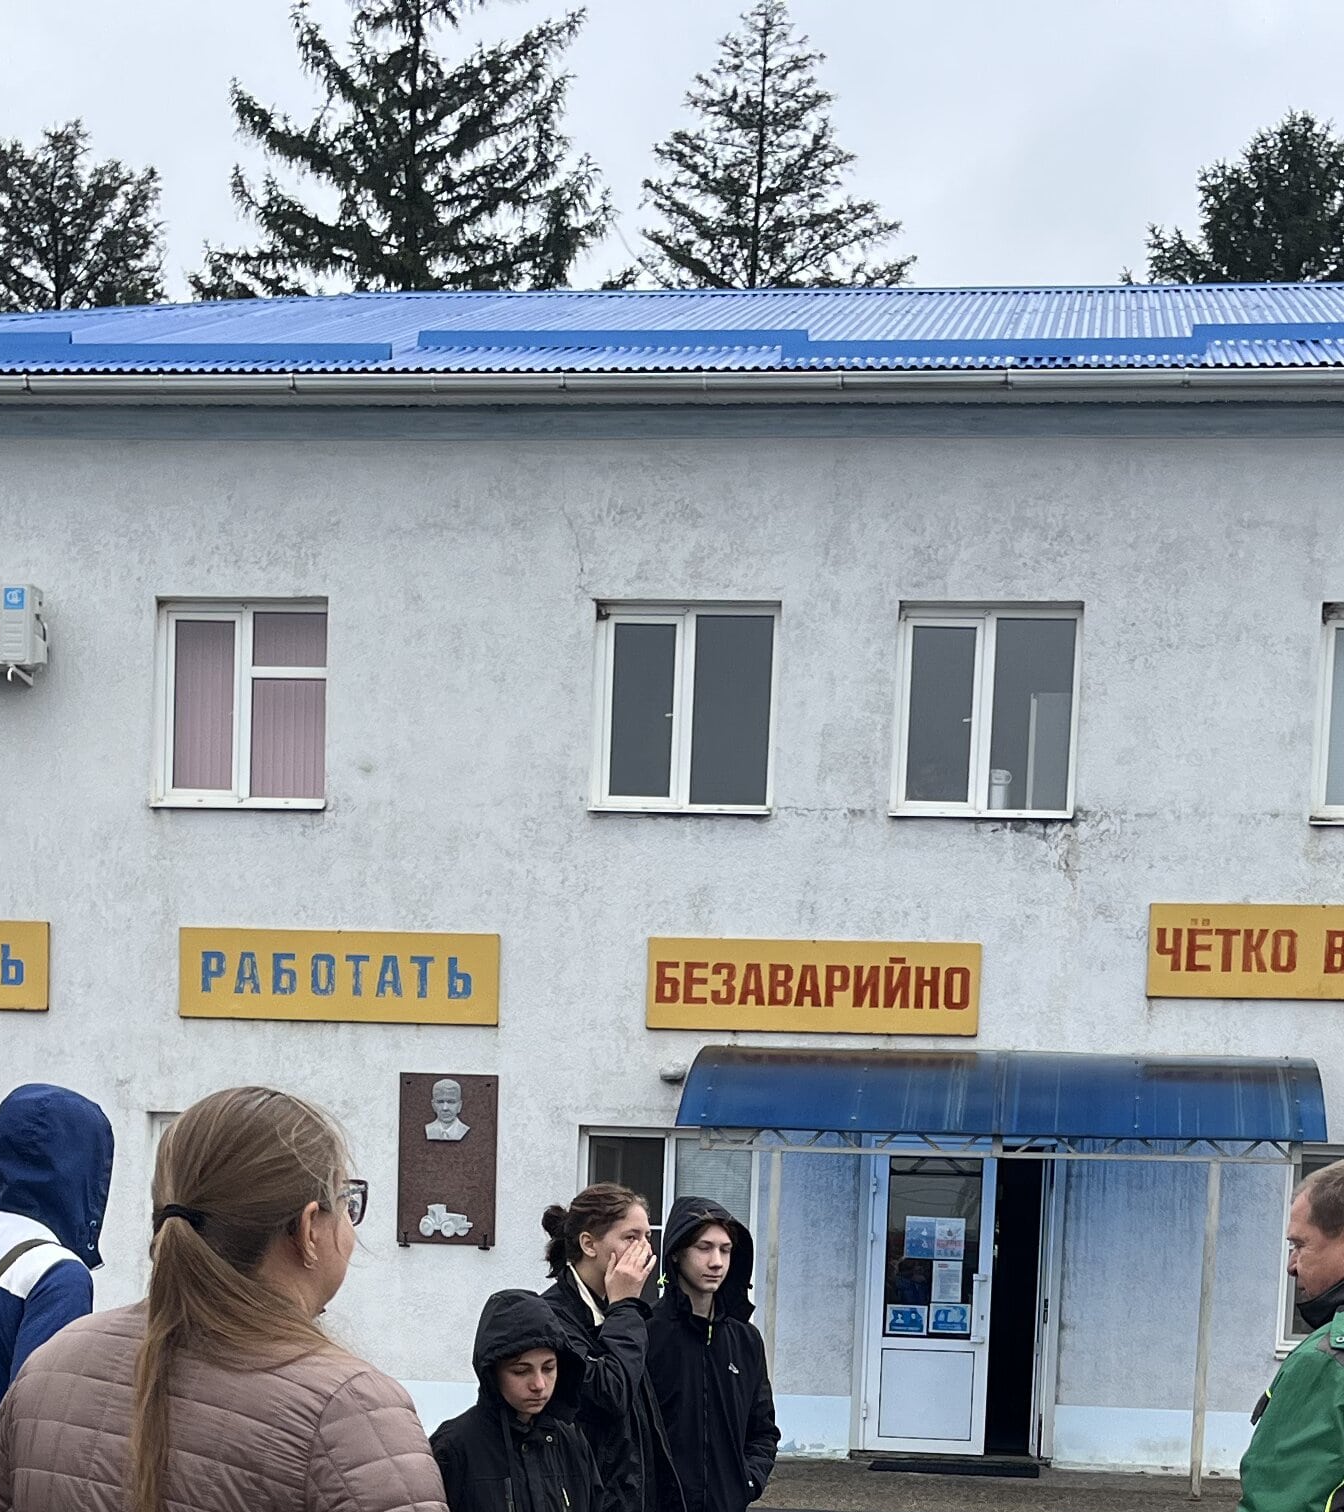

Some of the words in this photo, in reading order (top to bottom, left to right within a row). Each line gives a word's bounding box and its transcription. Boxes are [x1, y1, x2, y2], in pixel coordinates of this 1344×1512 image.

[1156, 917, 1299, 974] ЧЁТКО
[200, 950, 472, 1000] РАБОТАТЬ
[654, 956, 971, 1011] БЕЗАВАРИЙНО
